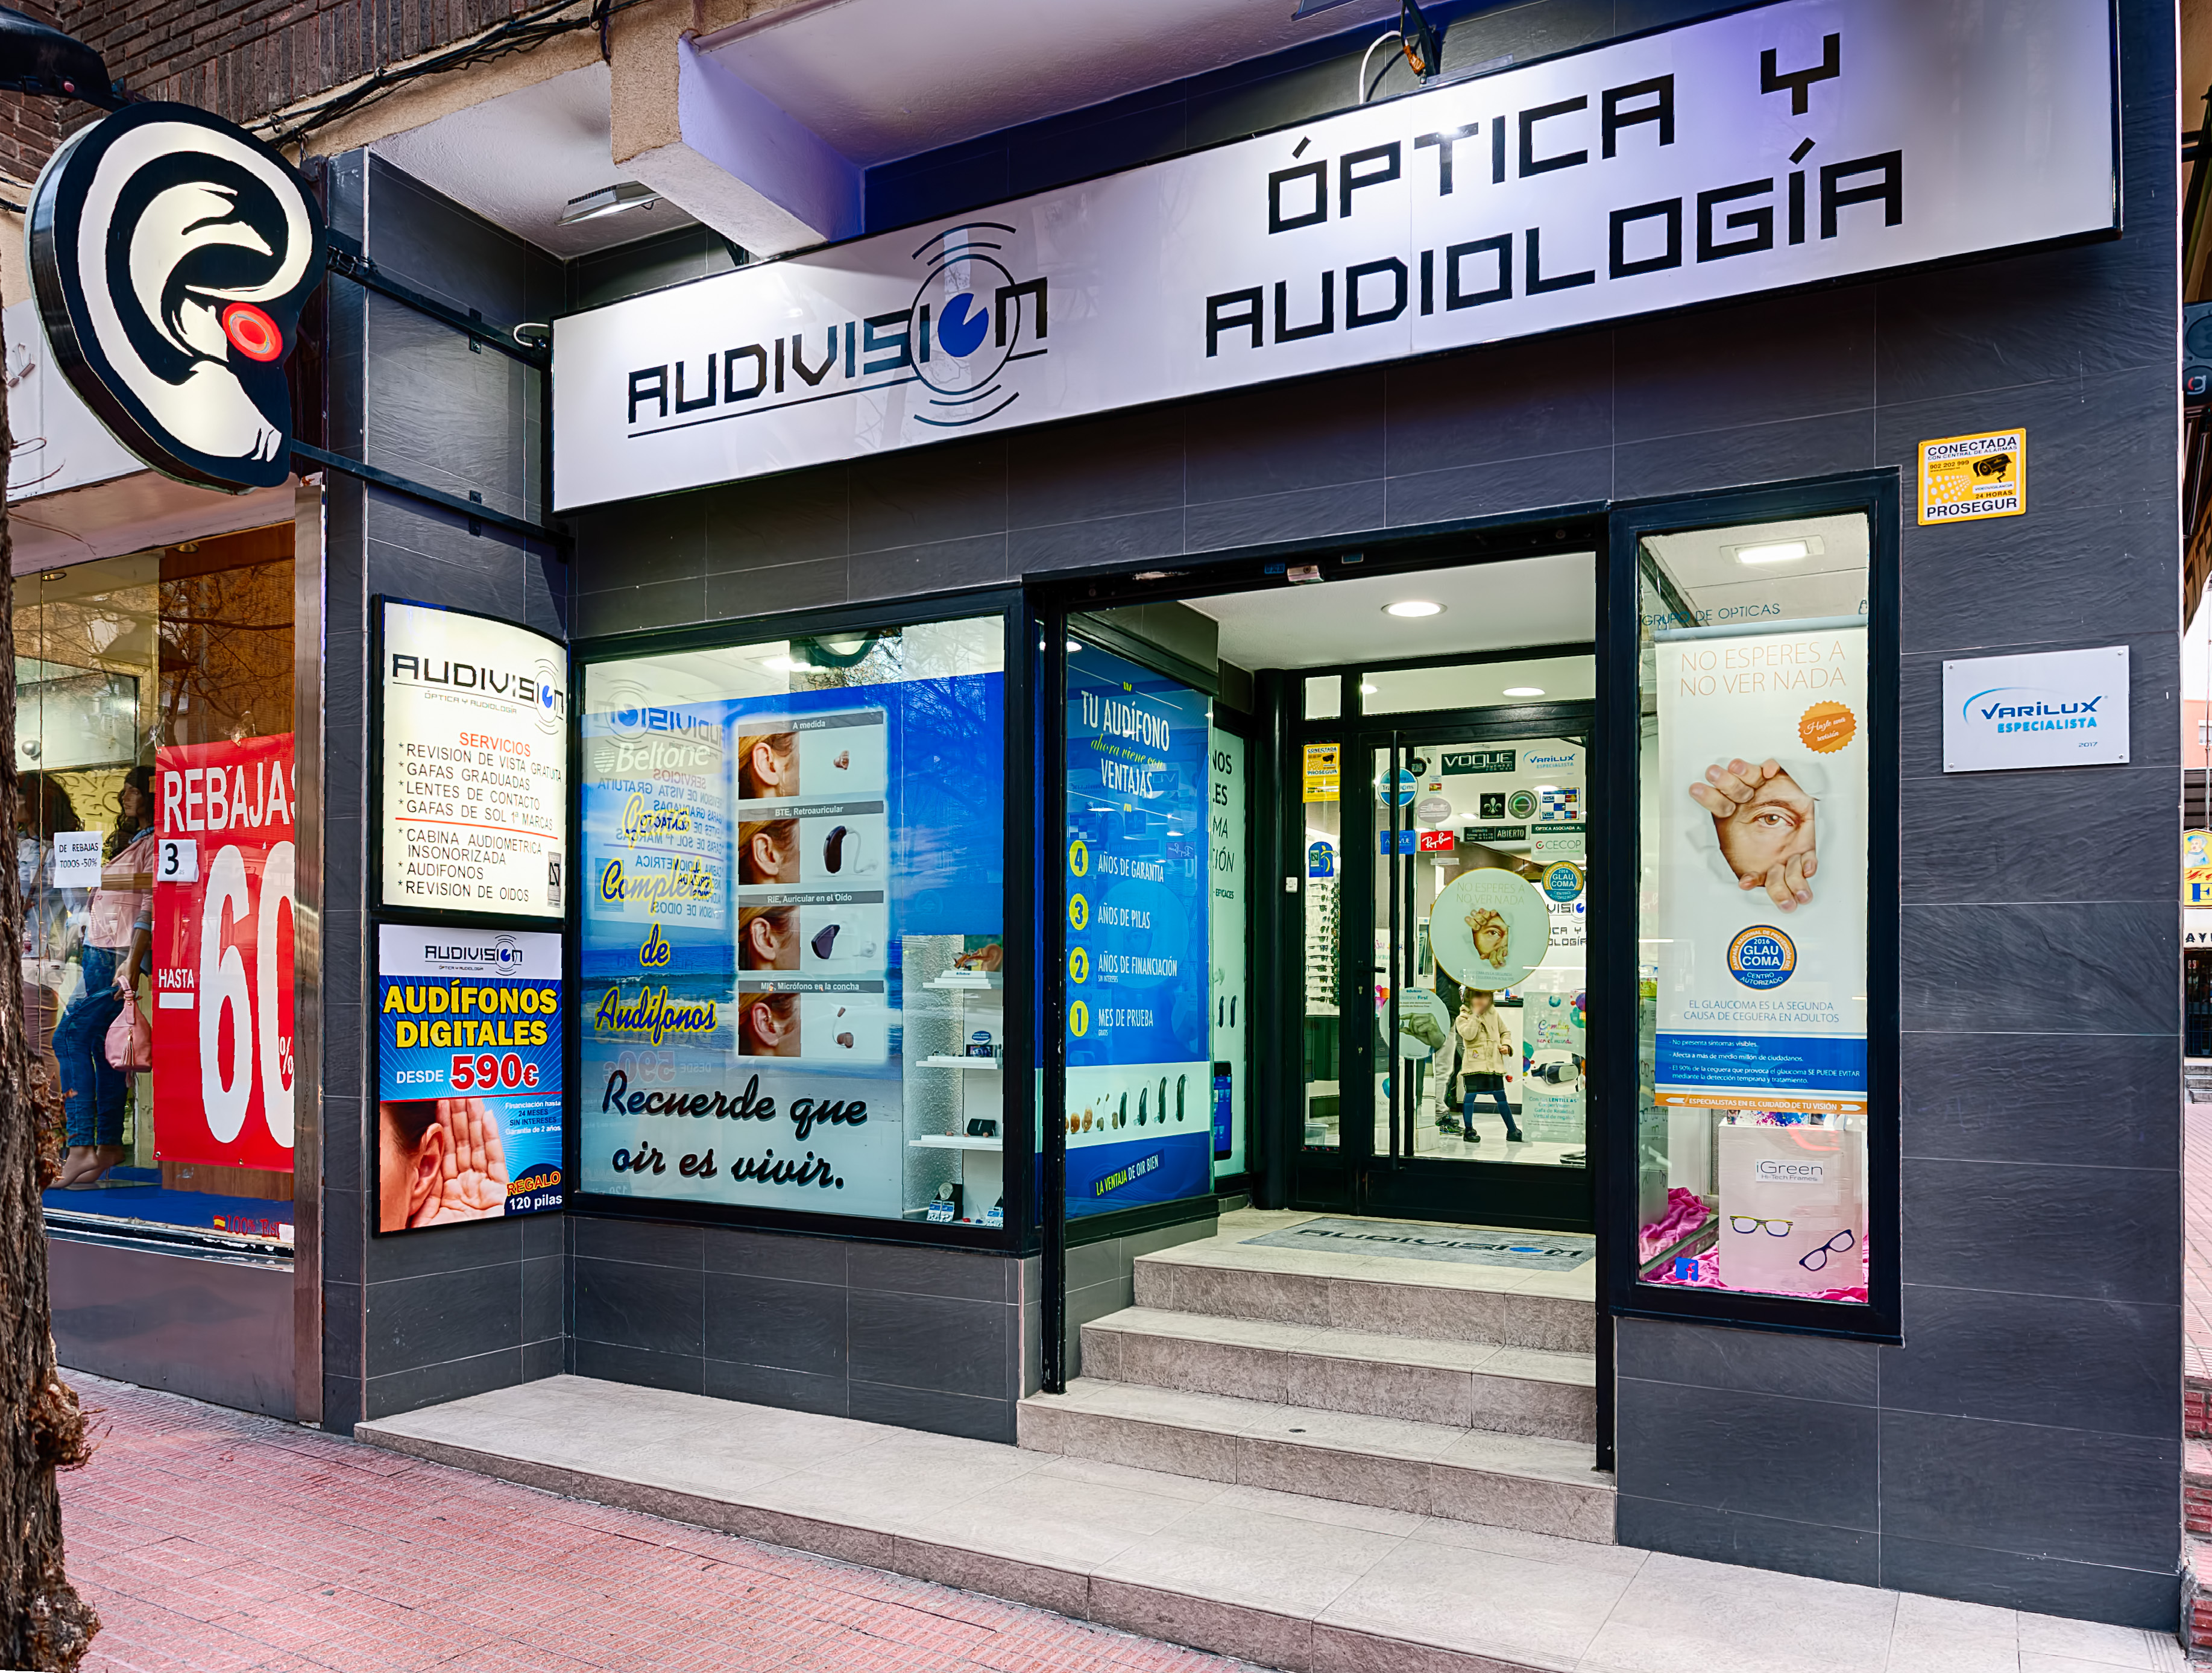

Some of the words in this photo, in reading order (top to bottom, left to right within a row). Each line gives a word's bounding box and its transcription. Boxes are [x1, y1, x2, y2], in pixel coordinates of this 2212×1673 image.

[1268, 73, 1675, 235] ÓPTICA
[1760, 33, 1841, 116] Y
[1206, 137, 1903, 359] AUDIOLOGÍA
[1927, 436, 2017, 456] CONECTADA
[1985, 490, 2013, 498] HORAS
[1927, 497, 2017, 518] PROSEGUR
[1642, 610, 1691, 626] GRUPO
[1695, 609, 1713, 622] DE
[1718, 603, 1780, 618] OPTICAS
[1681, 650, 1717, 672] NO
[1725, 641, 1821, 669] ESPERES
[1829, 640, 1846, 662] A
[1680, 675, 1716, 697] NO
[1722, 672, 1765, 695] VER
[1774, 667, 1847, 692] NADA
[424, 690, 459, 704] ÓPTICA
[470, 699, 517, 714] AUDIOLOGÍA
[1980, 695, 2102, 720] VARILUX
[799, 720, 826, 729] medida
[1081, 690, 1098, 728] TU
[1103, 701, 1170, 752] AUDÍFONO
[1997, 717, 2097, 734] ESPECIALISTA
[459, 732, 531, 757] SERVICIOS
[1091, 733, 1120, 755] ahora
[407, 743, 471, 763] REVISION
[479, 752, 494, 766] DE
[499, 755, 526, 773] VISTA
[616, 741, 711, 773] Beltone
[1530, 753, 1575, 763] VARILUX
[407, 762, 454, 780] GAFAS
[462, 768, 530, 791] GRADUADAS
[1101, 758, 1153, 799] VENTAJAS
[163, 760, 295, 834] REBAJA
[407, 781, 460, 799] LENTES
[467, 787, 483, 801] DE
[490, 790, 540, 811] CONTACTO
[407, 799, 453, 816] GAFAS
[461, 805, 477, 819] DE
[485, 807, 506, 822] SOL
[522, 813, 553, 831] MARCAS
[793, 805, 843, 816] Retroauricular
[407, 828, 459, 845] CABINA
[468, 834, 541, 855] AUDIOMETRICA
[1497, 829, 1524, 837] ABIERTO
[59, 843, 68, 853] DE
[72, 842, 99, 852] REBAJAS
[408, 844, 506, 865] INSONORIZADA
[1545, 840, 1581, 849] CECOP
[59, 859, 80, 868] TODOS
[164, 842, 180, 875] 3
[1098, 851, 1118, 875] AÑOS
[1120, 858, 1130, 877] DE
[1131, 860, 1164, 883] GARANTIA
[407, 862, 484, 880] AUDIFONOS
[406, 881, 471, 897] REVISION
[478, 885, 493, 899] DE
[500, 887, 529, 902] OIDOS
[1457, 882, 1473, 892] NO
[1475, 883, 1515, 893] ESPERES
[783, 895, 815, 904] Auricular
[1457, 893, 1472, 903] NO
[1474, 894, 1492, 904] VER
[1495, 895, 1525, 905] NADA
[1074, 900, 1083, 925] 3
[1098, 903, 1118, 925] AÑOS
[1120, 909, 1130, 927] DE
[1131, 910, 1151, 929] PILAS
[640, 921, 670, 966] de
[1744, 945, 1779, 955] GLAU
[1098, 951, 1118, 973] AÑOS
[1120, 956, 1130, 974] DE
[1131, 956, 1177, 977] FINANCIACIÓN
[1742, 956, 1781, 966] COMA
[158, 968, 195, 989] HASTA
[778, 981, 813, 990] Micrófono
[1740, 977, 1783, 985] AUTORIZADO
[382, 978, 558, 1015] AUDÍFONOS
[1689, 1000, 1700, 1009] EL
[1702, 1000, 1757, 1009] GLAUCOMA
[1759, 1001, 1769, 1010] ES
[1772, 1001, 1785, 1010] LA
[1786, 1001, 1833, 1011] SEGUNDA
[1098, 1008, 1114, 1027] MES
[1115, 1009, 1126, 1027] DE
[1127, 1009, 1153, 1027] PRUEBA
[1684, 1011, 1716, 1020] CAUSA
[1718, 1012, 1731, 1021] DE
[1733, 1012, 1777, 1021] CEGUERA
[1779, 1013, 1791, 1021] EN
[1794, 1013, 1839, 1023] ADULTOS
[395, 1019, 549, 1048] DIGITALES
[396, 1070, 444, 1084] DESDE
[450, 1052, 540, 1091] 590€
[602, 1070, 777, 1120] Recuerde
[789, 1097, 868, 1141] que
[1689, 1098, 1737, 1106] ESPECIALISTAS
[1812, 1102, 1837, 1111] VISIÓN
[521, 1117, 557, 1125] INTERESES
[612, 1141, 666, 1175] oir
[678, 1148, 717, 1178] es
[730, 1148, 845, 1189] vivir.
[1095, 1180, 1104, 1197] LA
[1104, 1169, 1127, 1193] VENTAJA
[1129, 1167, 1136, 1180] DE
[1136, 1161, 1146, 1177] OIR
[1147, 1155, 1159, 1172] BIEN
[1756, 1161, 1823, 1176] iGreen
[506, 1171, 561, 1197] REGALO
[509, 1196, 531, 1210] 120
[534, 1194, 563, 1210] pilas
